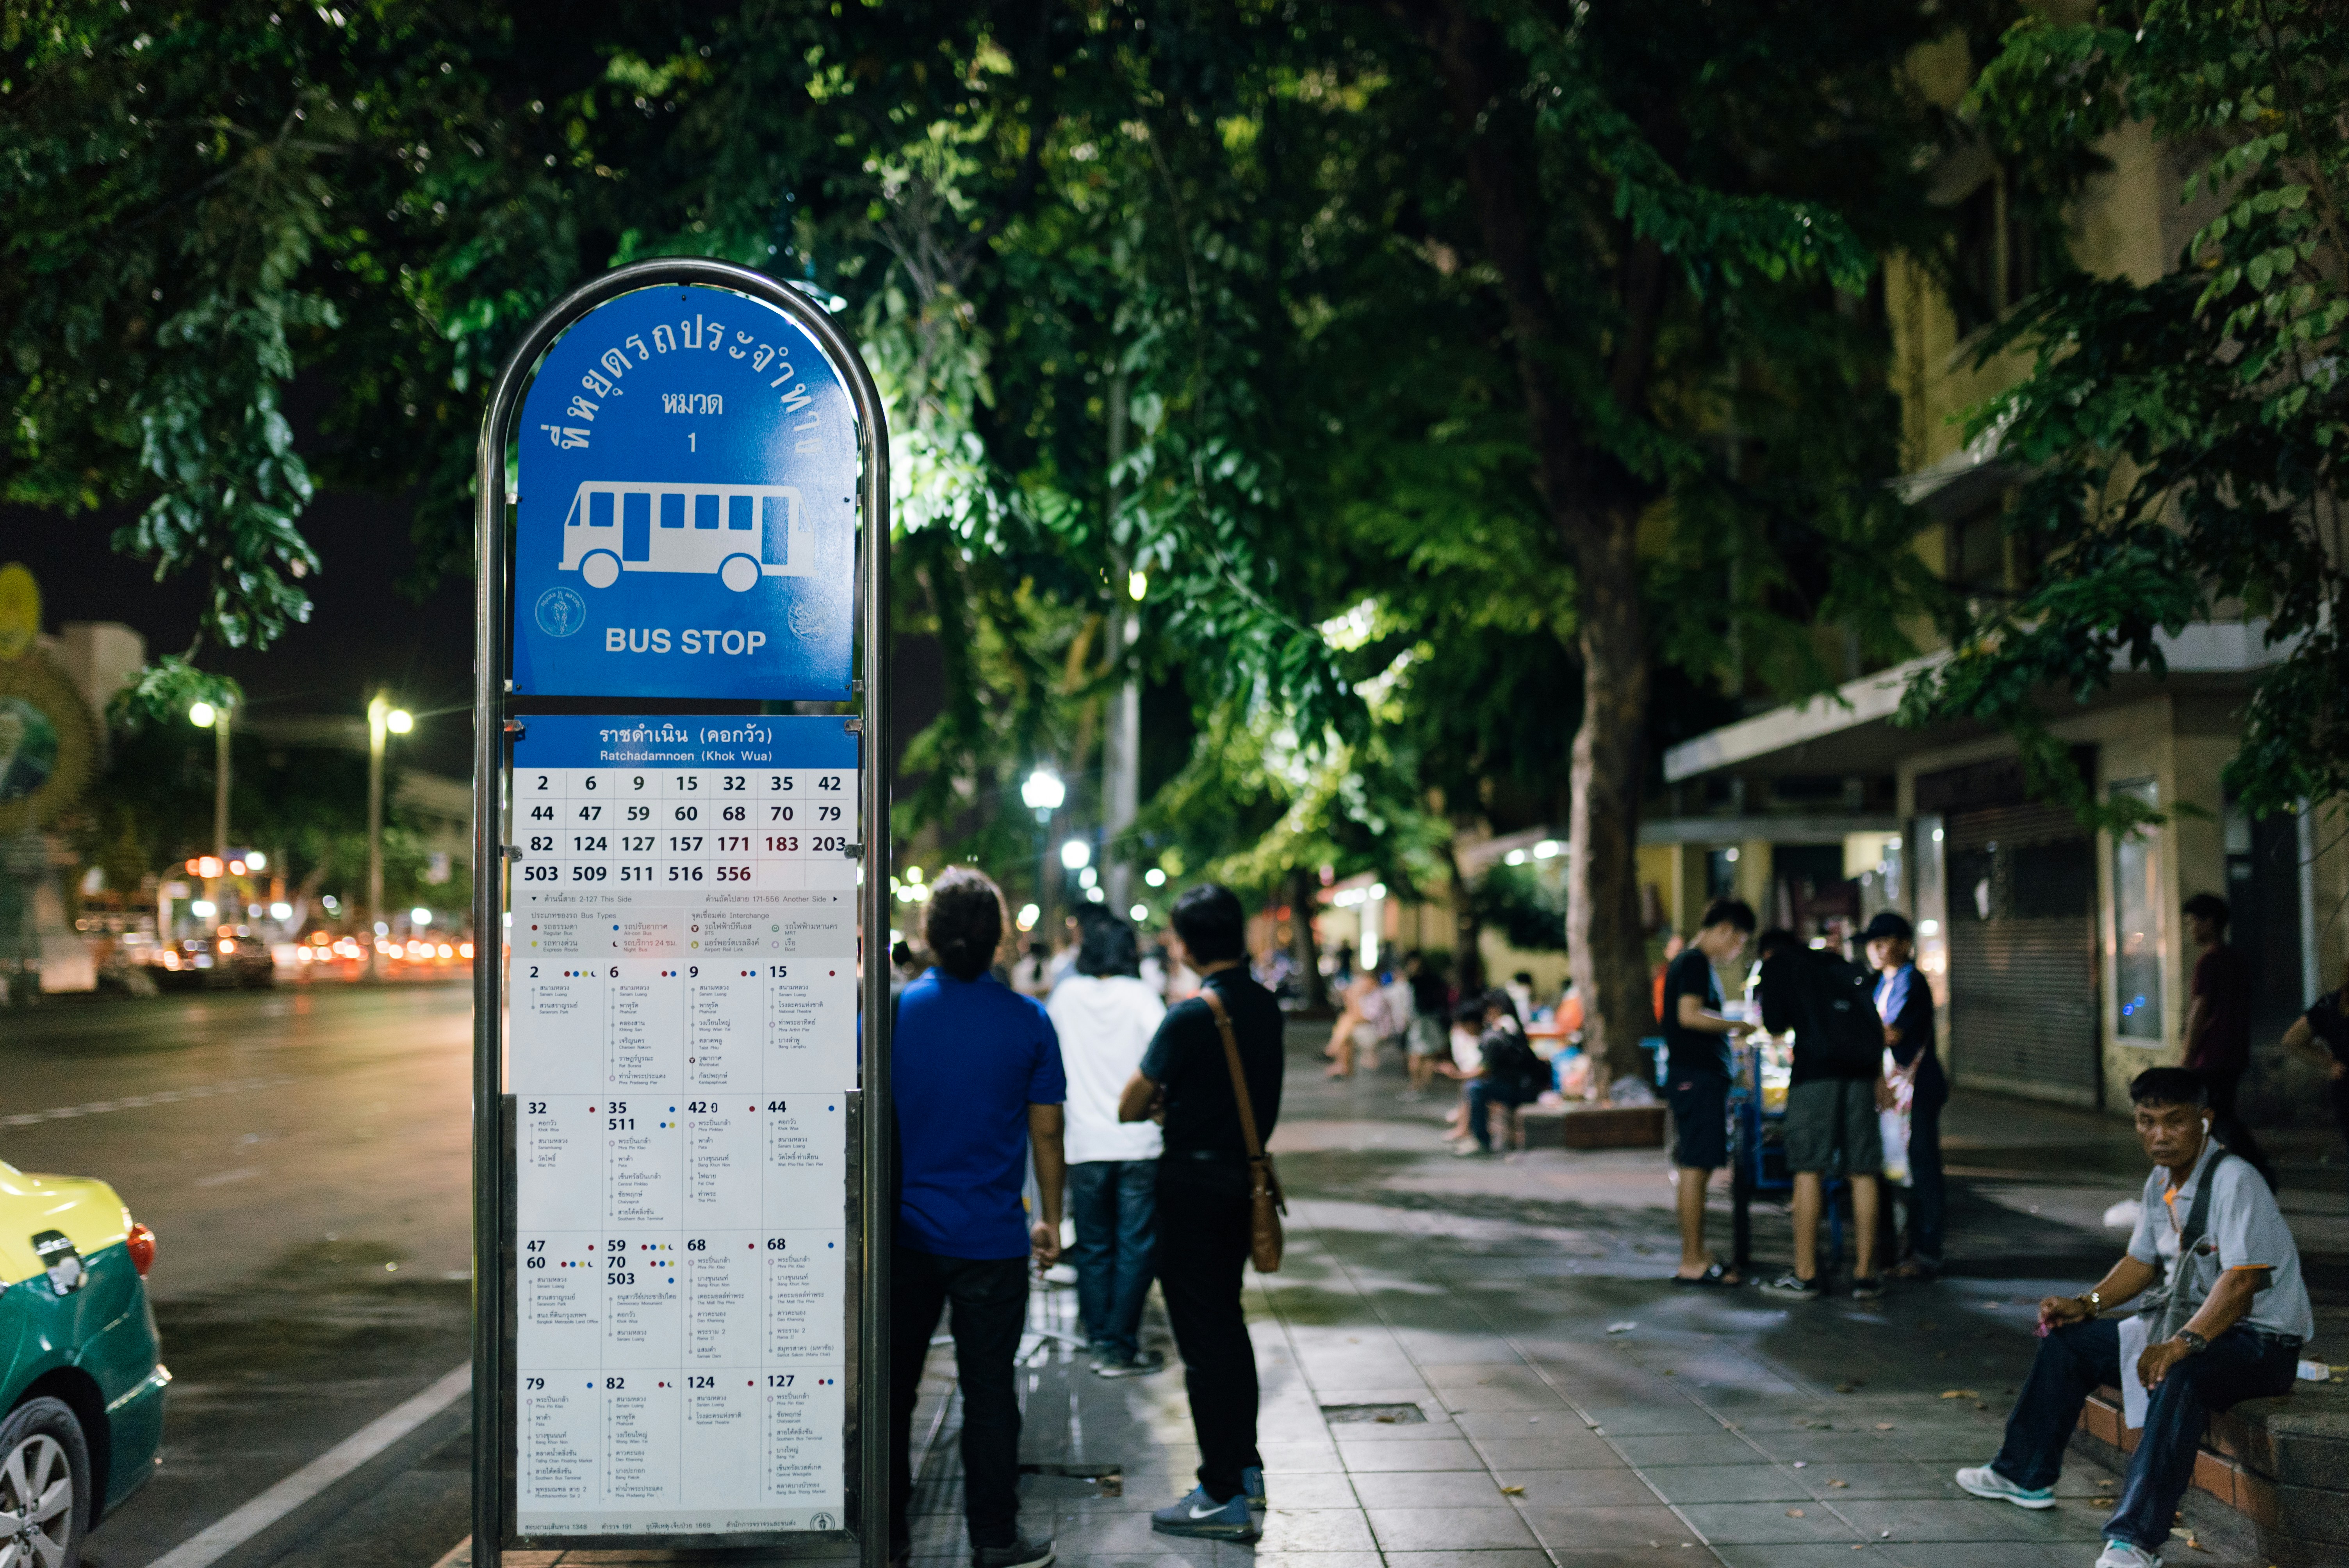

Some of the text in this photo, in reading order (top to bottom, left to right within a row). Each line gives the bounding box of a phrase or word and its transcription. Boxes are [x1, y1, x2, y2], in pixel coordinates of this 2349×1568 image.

[541, 314, 822, 454] ที่หยุดรถประจำทาง
[662, 394, 722, 414] หมวด
[688, 433, 695, 452] 1
[606, 628, 766, 655] BUS STOP
[600, 723, 772, 744] ราชดำเนิน (คอกวัว)
[601, 750, 772, 761] Ratchadamnoen (Khok Wua)
[538, 776, 840, 790] 2 6 9 15 32 35 42
[531, 806, 841, 821] 44 47 59 60 68 70 79
[531, 837, 846, 851] 82 124 127 157 171 183 203
[525, 866, 750, 881] 503 509 511 516 556
[545, 892, 575, 902] ด้านนี้สาย
[692, 909, 726, 921] จุดเชื่อมต่อ
[530, 966, 538, 978] 2
[610, 966, 618, 978] 6
[690, 966, 698, 978] 9
[770, 966, 786, 977] 15
[699, 1019, 730, 1027] วงเวียนใหญ่
[779, 1037, 800, 1045] บางลำพู
[529, 1102, 546, 1114] 32
[609, 1102, 626, 1114] 35
[688, 1102, 706, 1113] 42
[768, 1101, 786, 1112] 44
[609, 1119, 634, 1130] 511
[527, 1240, 545, 1252] 47
[608, 1240, 626, 1251] 59
[688, 1239, 706, 1251] 68
[768, 1238, 785, 1250] 68
[527, 1257, 545, 1269] 60
[608, 1256, 626, 1268] 70
[608, 1273, 634, 1285] 503
[527, 1378, 544, 1390] 79
[606, 1377, 624, 1389] 82
[688, 1376, 714, 1388] 124
[768, 1375, 794, 1386] 127
[777, 1446, 798, 1454] บางใหญ่
